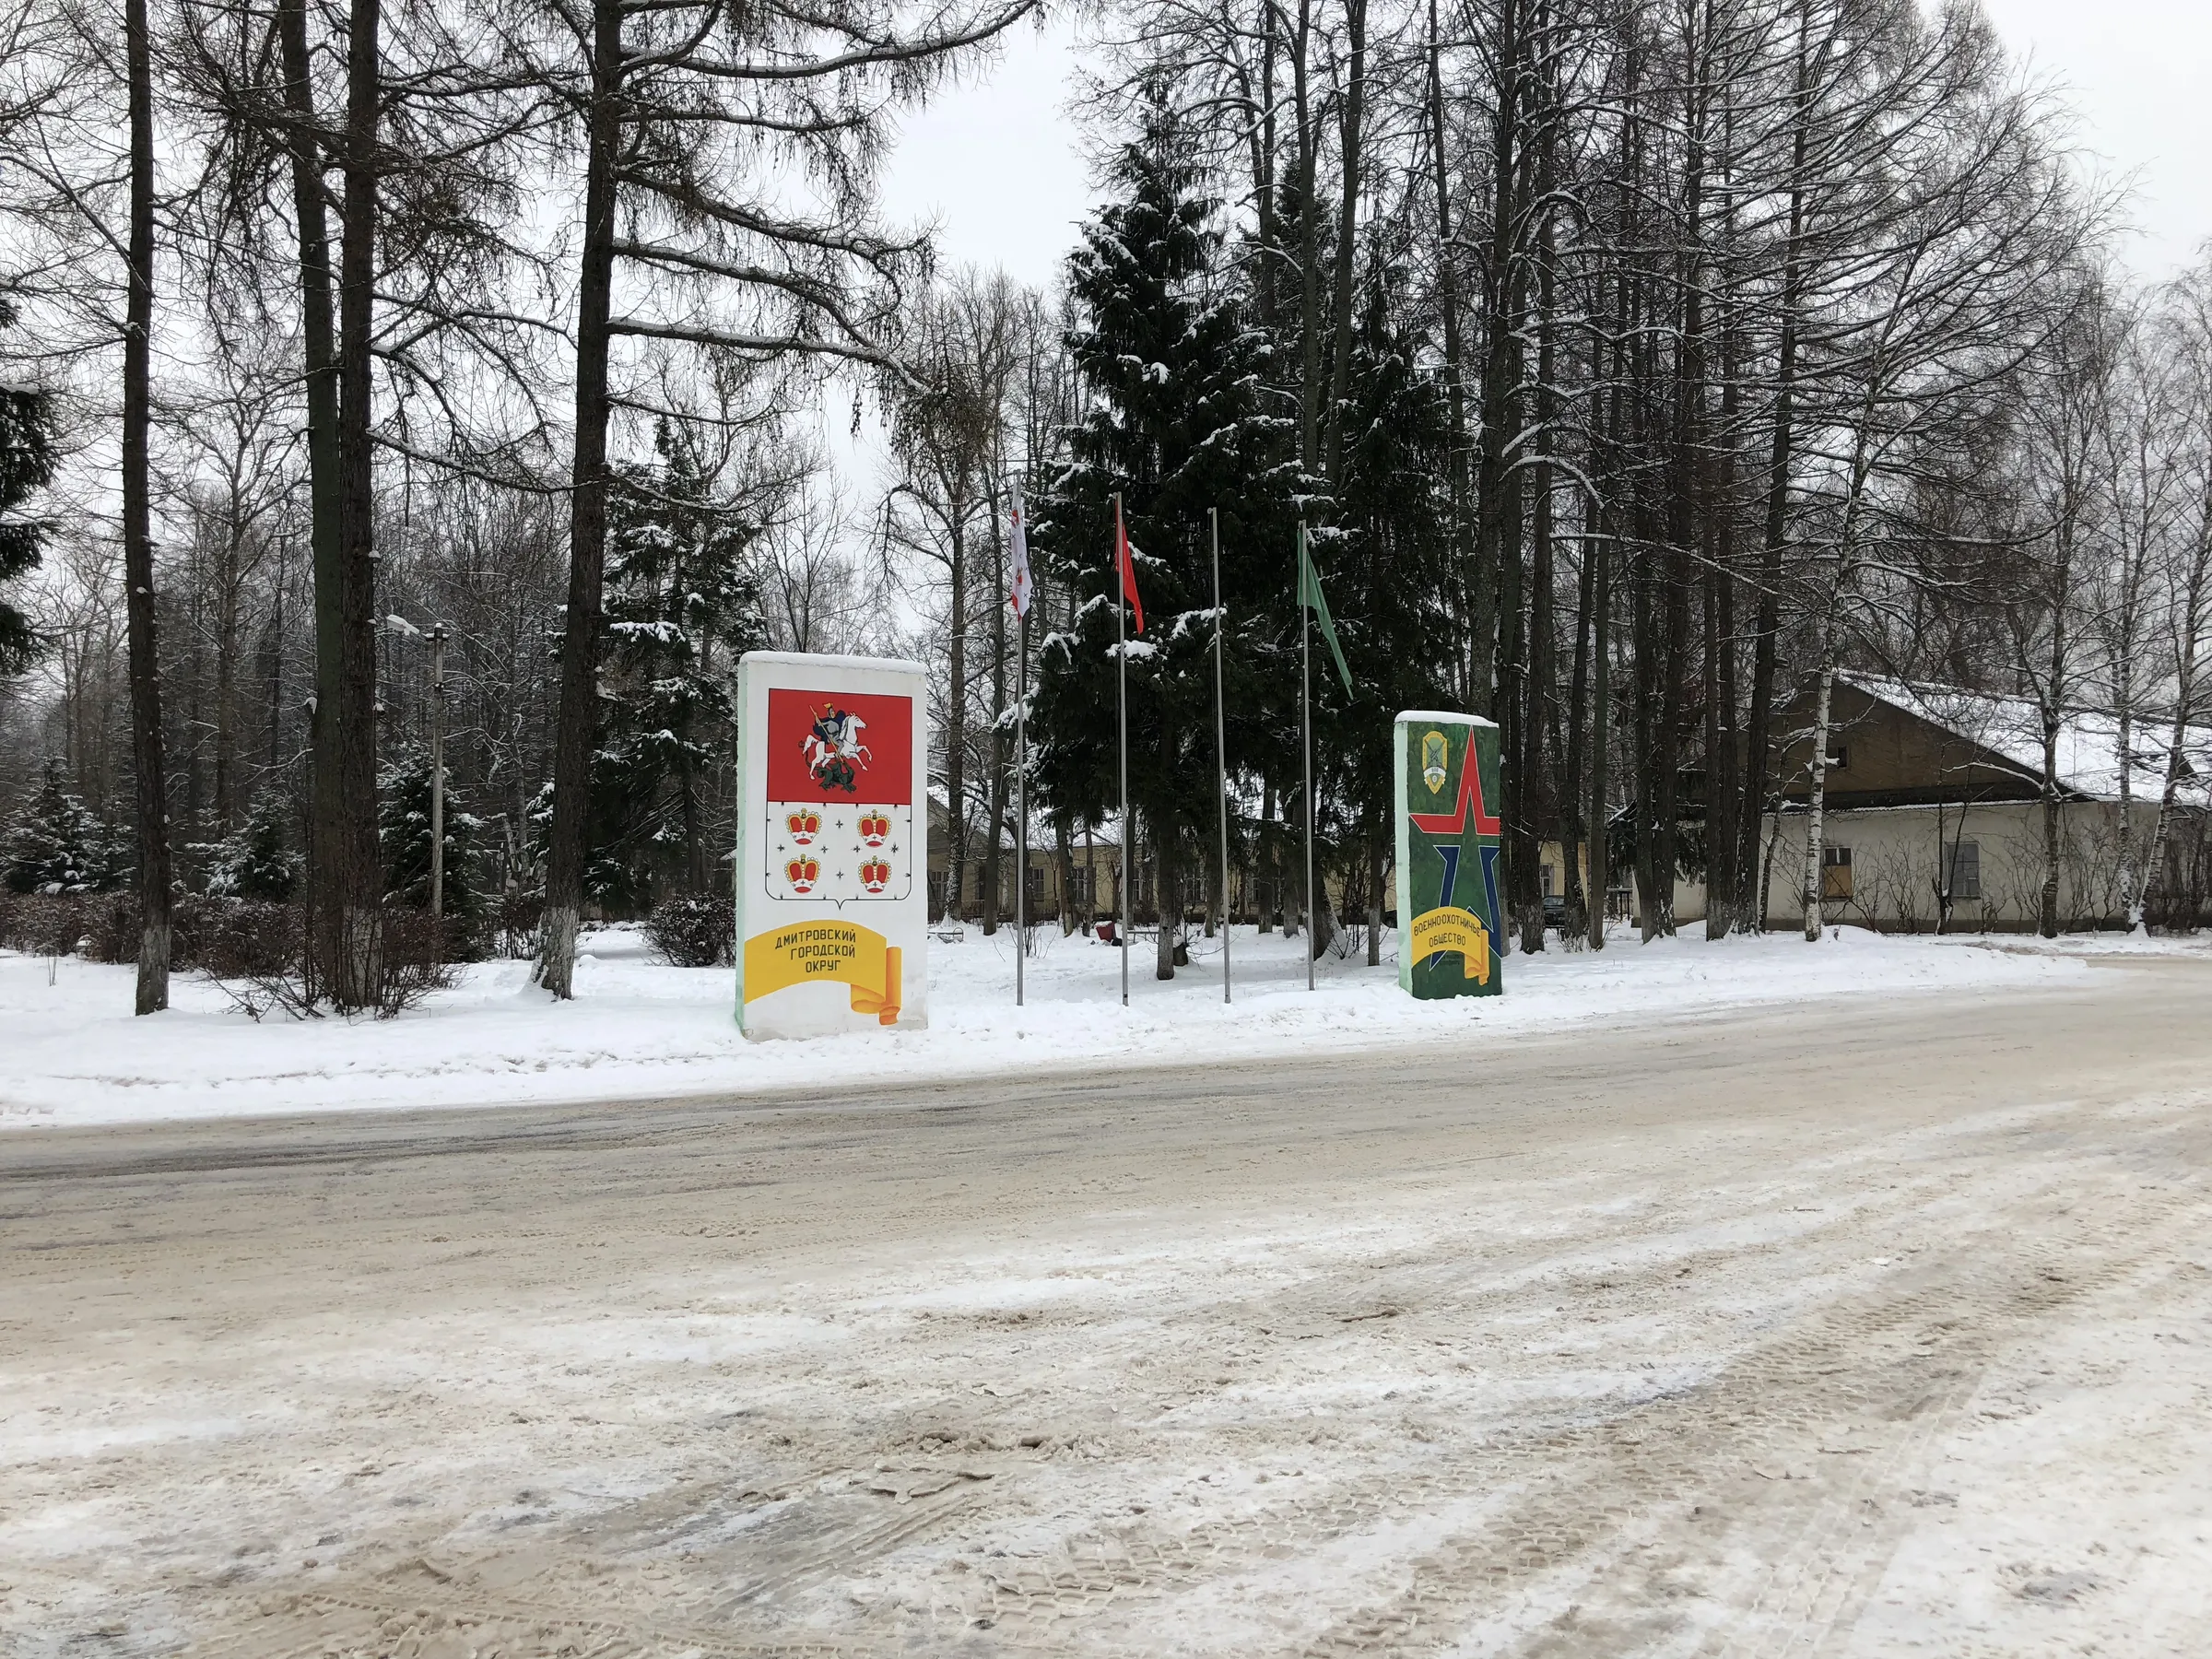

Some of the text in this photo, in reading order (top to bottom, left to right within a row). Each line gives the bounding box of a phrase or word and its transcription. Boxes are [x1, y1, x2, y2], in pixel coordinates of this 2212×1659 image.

[775, 929, 856, 949] ДМИТРОВСКИЙ
[1429, 933, 1466, 947] ОБЩЕСТВО
[791, 945, 855, 960] ГОРОДСКОЙ
[806, 959, 841, 973] ОКРУГ
